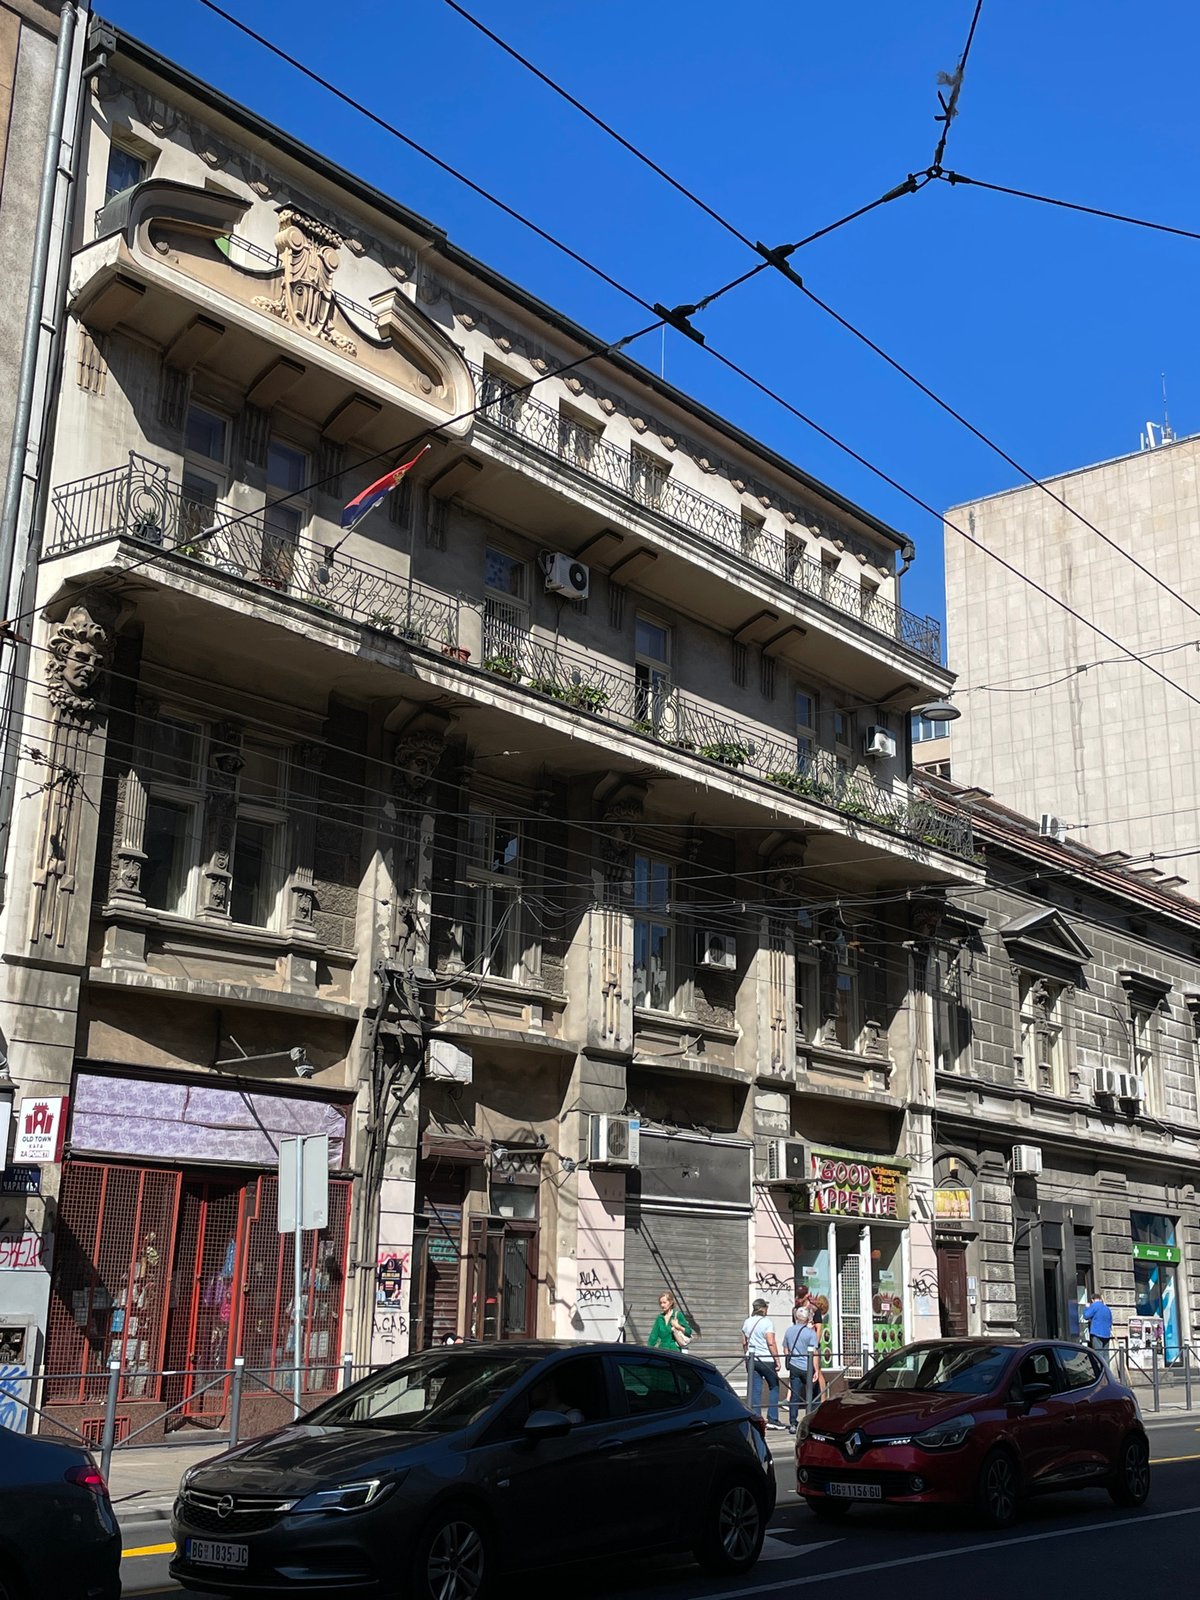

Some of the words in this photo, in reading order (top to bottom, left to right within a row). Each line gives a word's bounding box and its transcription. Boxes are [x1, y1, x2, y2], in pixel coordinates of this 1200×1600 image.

[822, 1160, 870, 1186] GOOD
[832, 1484, 841, 1495] BG
[193, 1542, 203, 1558] BG
